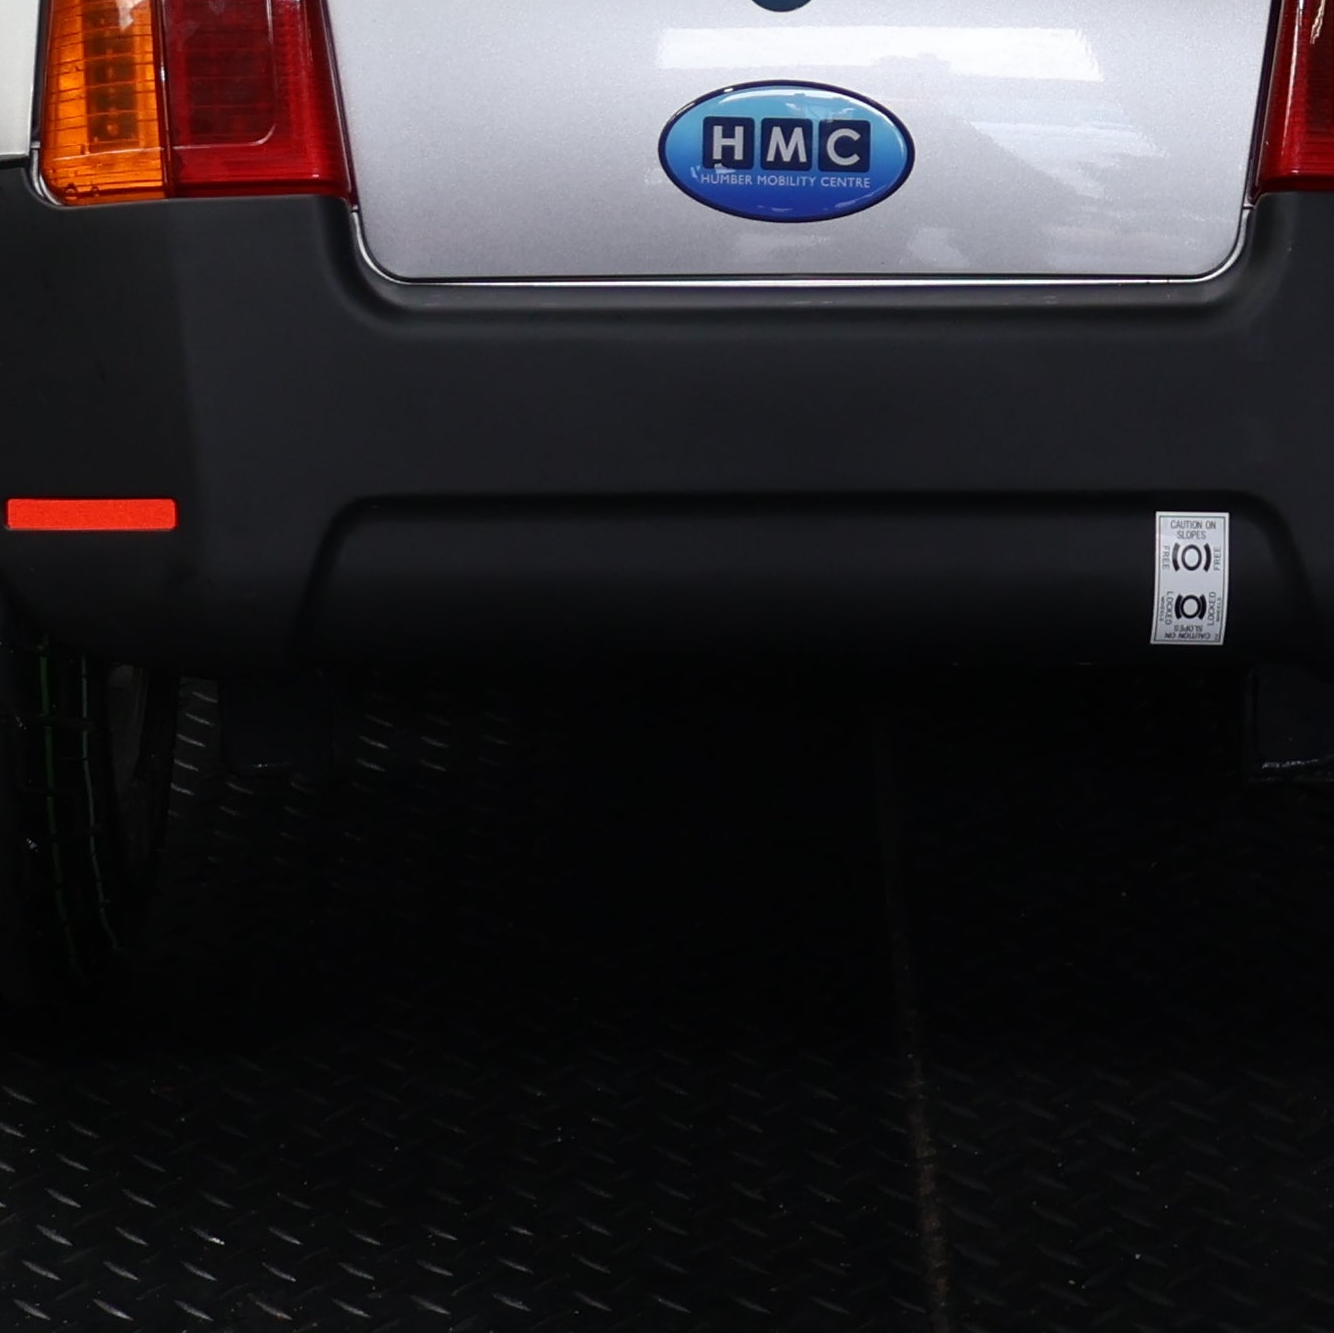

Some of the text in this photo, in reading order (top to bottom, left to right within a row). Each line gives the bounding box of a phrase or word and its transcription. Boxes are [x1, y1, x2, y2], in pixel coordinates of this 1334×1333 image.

[712, 125, 861, 166] HMC
[700, 173, 870, 188] HUMBER MOBILITY CENTRE
[1170, 520, 1216, 530] CAUTION ON
[1177, 530, 1207, 540] SLOPES
[1162, 546, 1171, 570] FREE
[1214, 547, 1222, 571] FREE
[1165, 591, 1174, 625] LOCKED
[1207, 592, 1216, 626] LOCKED
[1179, 632, 1211, 640] CAUTION
